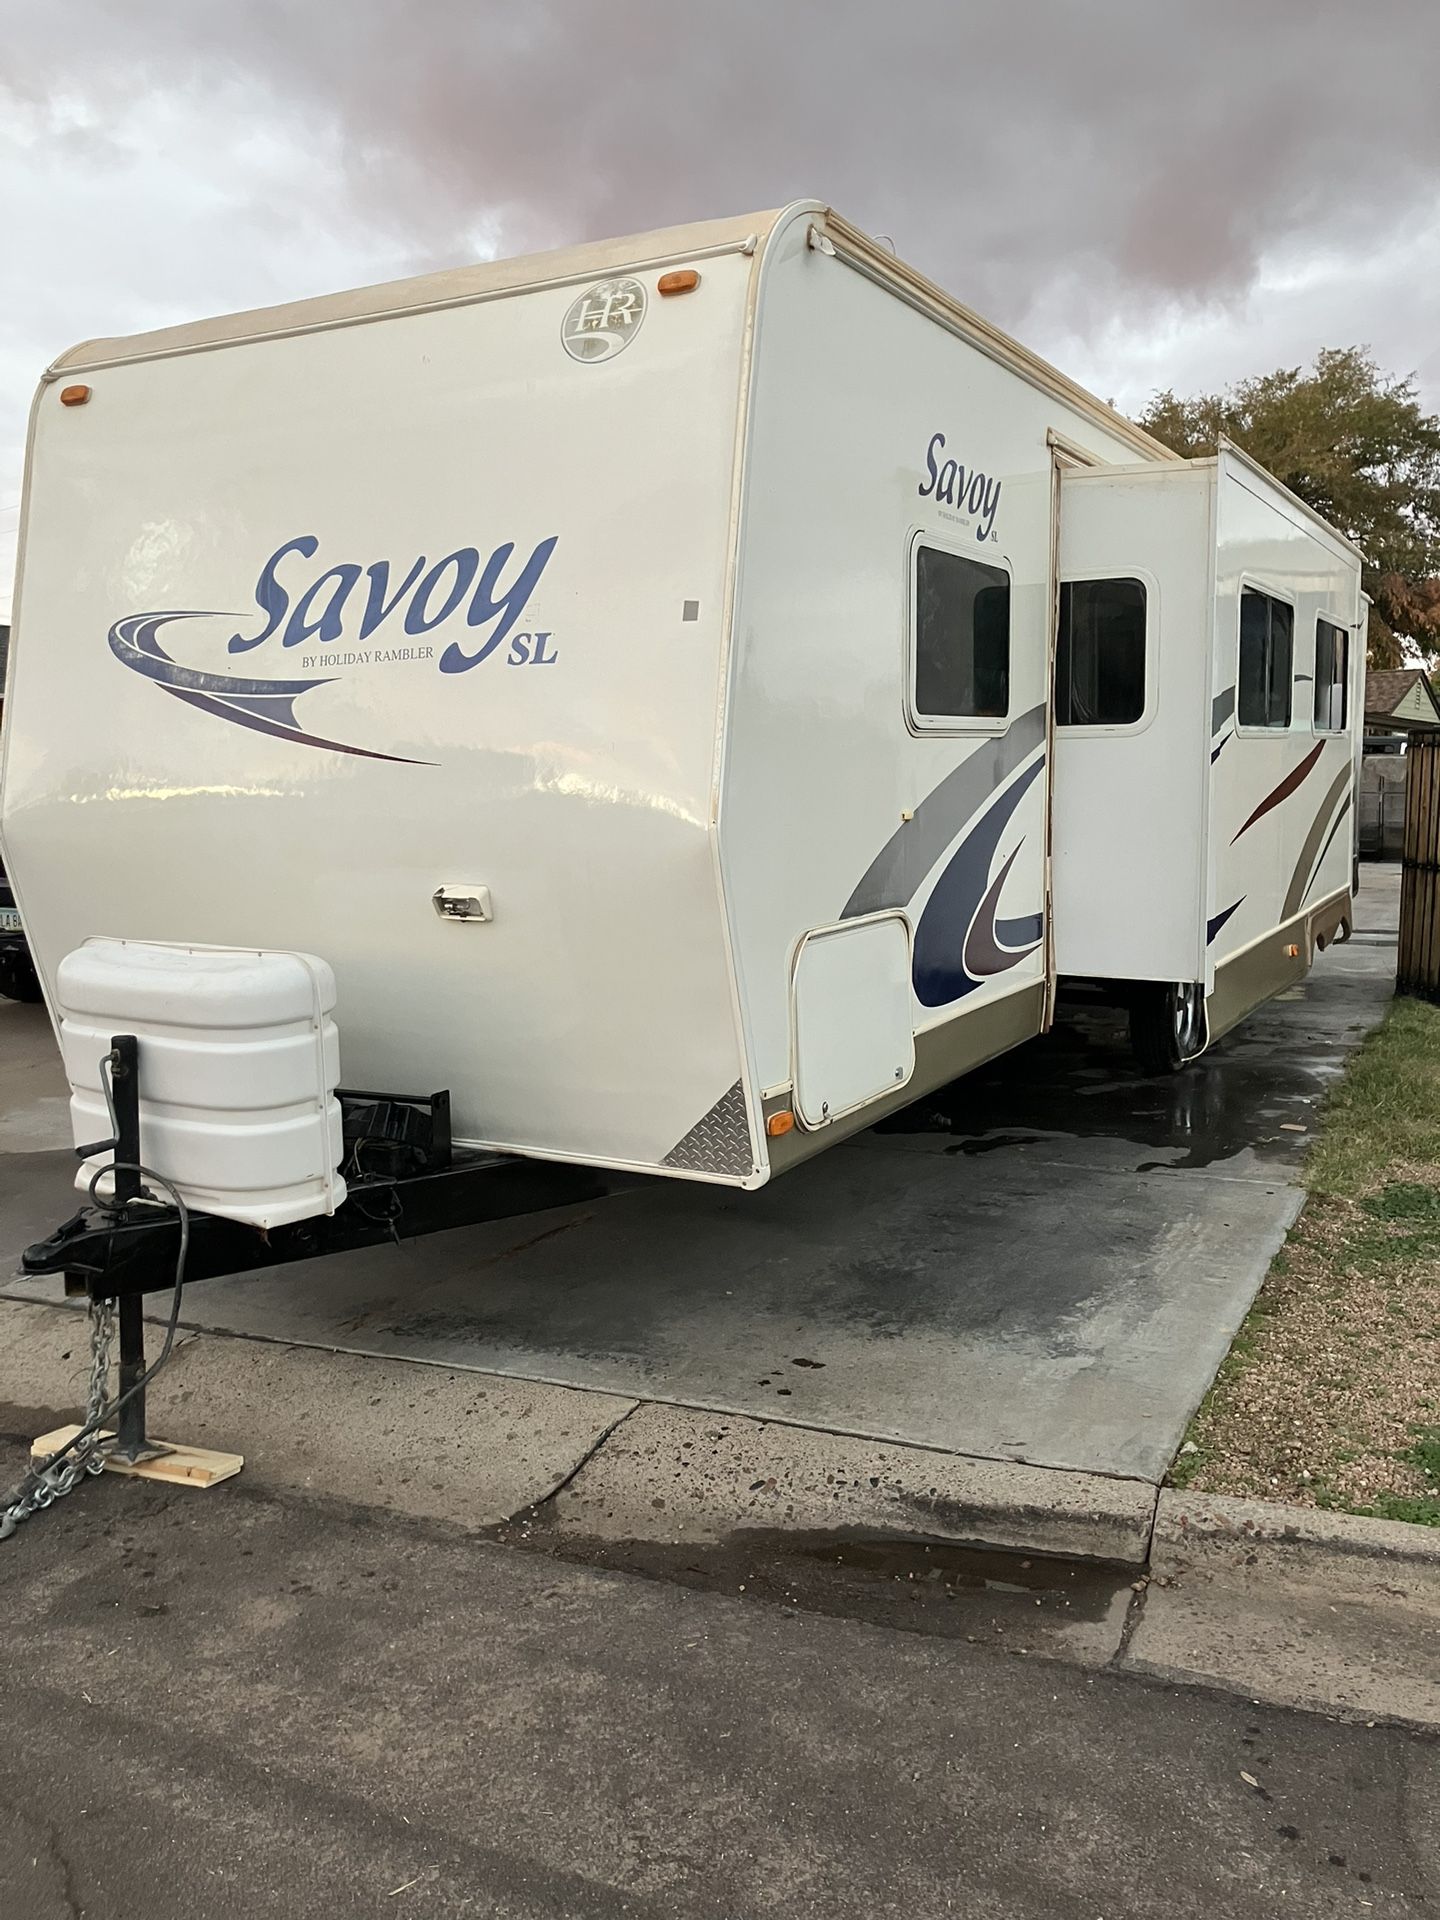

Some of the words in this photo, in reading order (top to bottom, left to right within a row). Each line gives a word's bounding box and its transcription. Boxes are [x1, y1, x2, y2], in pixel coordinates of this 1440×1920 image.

[574, 292, 636, 332] HR
[918, 432, 1002, 542] Savoy
[227, 534, 560, 674] Savoy
[302, 656, 317, 668] BY
[320, 651, 372, 667] HOLIDAY
[374, 646, 434, 662] RAMBLER
[507, 632, 559, 666] SL
